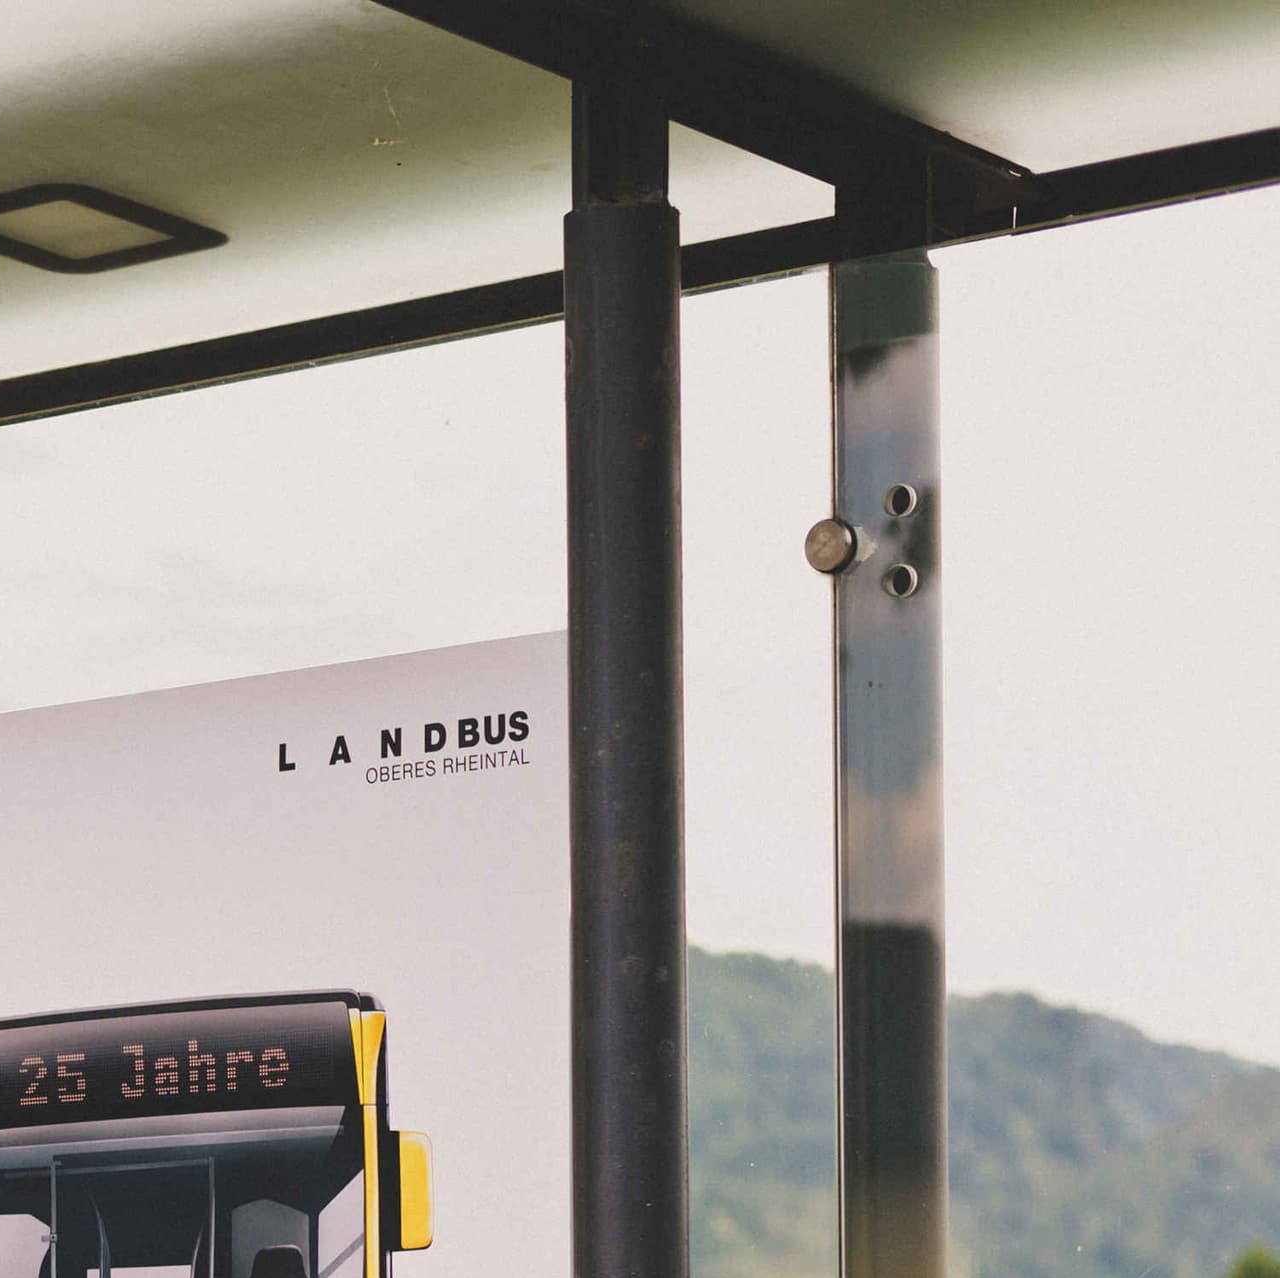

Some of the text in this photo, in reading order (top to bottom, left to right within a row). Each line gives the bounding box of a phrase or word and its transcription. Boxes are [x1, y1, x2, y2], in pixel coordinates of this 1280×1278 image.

[278, 710, 530, 772] LANDBUS
[365, 748, 531, 784] OBERES RHEINTAL
[20, 1040, 289, 1105] 25 Jahre
